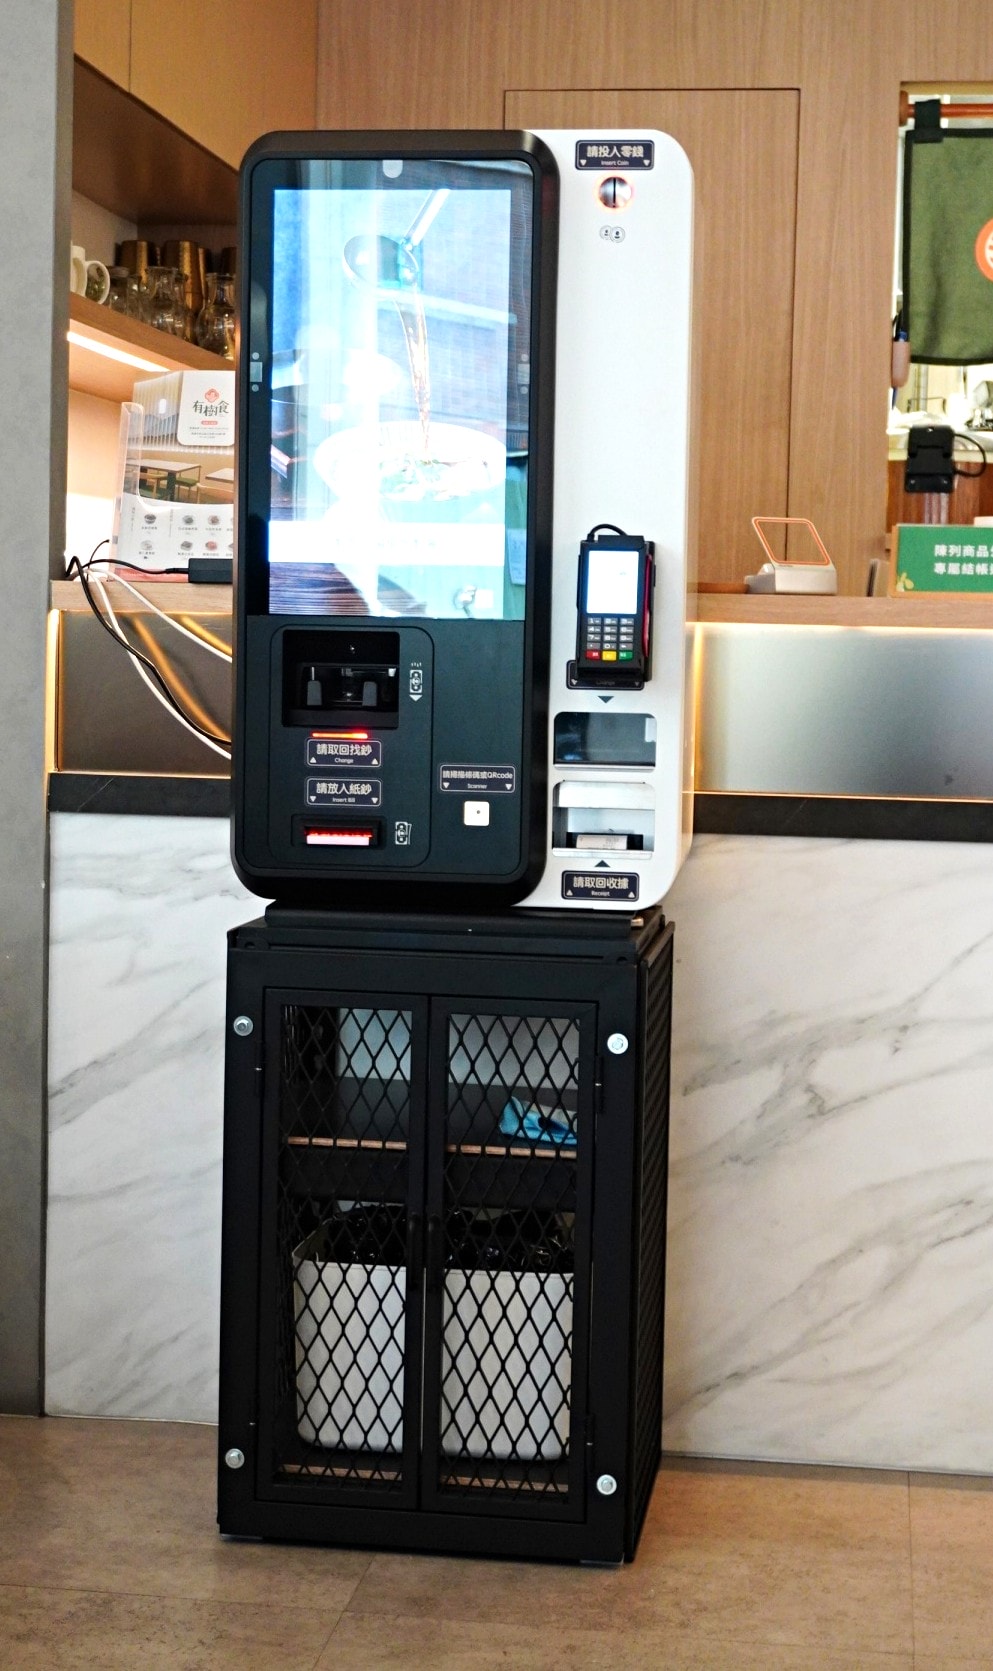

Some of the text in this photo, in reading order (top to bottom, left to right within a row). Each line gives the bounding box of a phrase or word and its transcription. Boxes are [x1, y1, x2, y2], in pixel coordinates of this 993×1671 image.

[586, 145, 644, 158] 請投入零錢
[934, 544, 993, 558] 陳列商品
[934, 562, 993, 575] 專屬結帳
[316, 743, 372, 756] 請取回找鈔
[316, 782, 372, 795] 請放入紙鈔
[573, 876, 629, 889] 請取回收據
